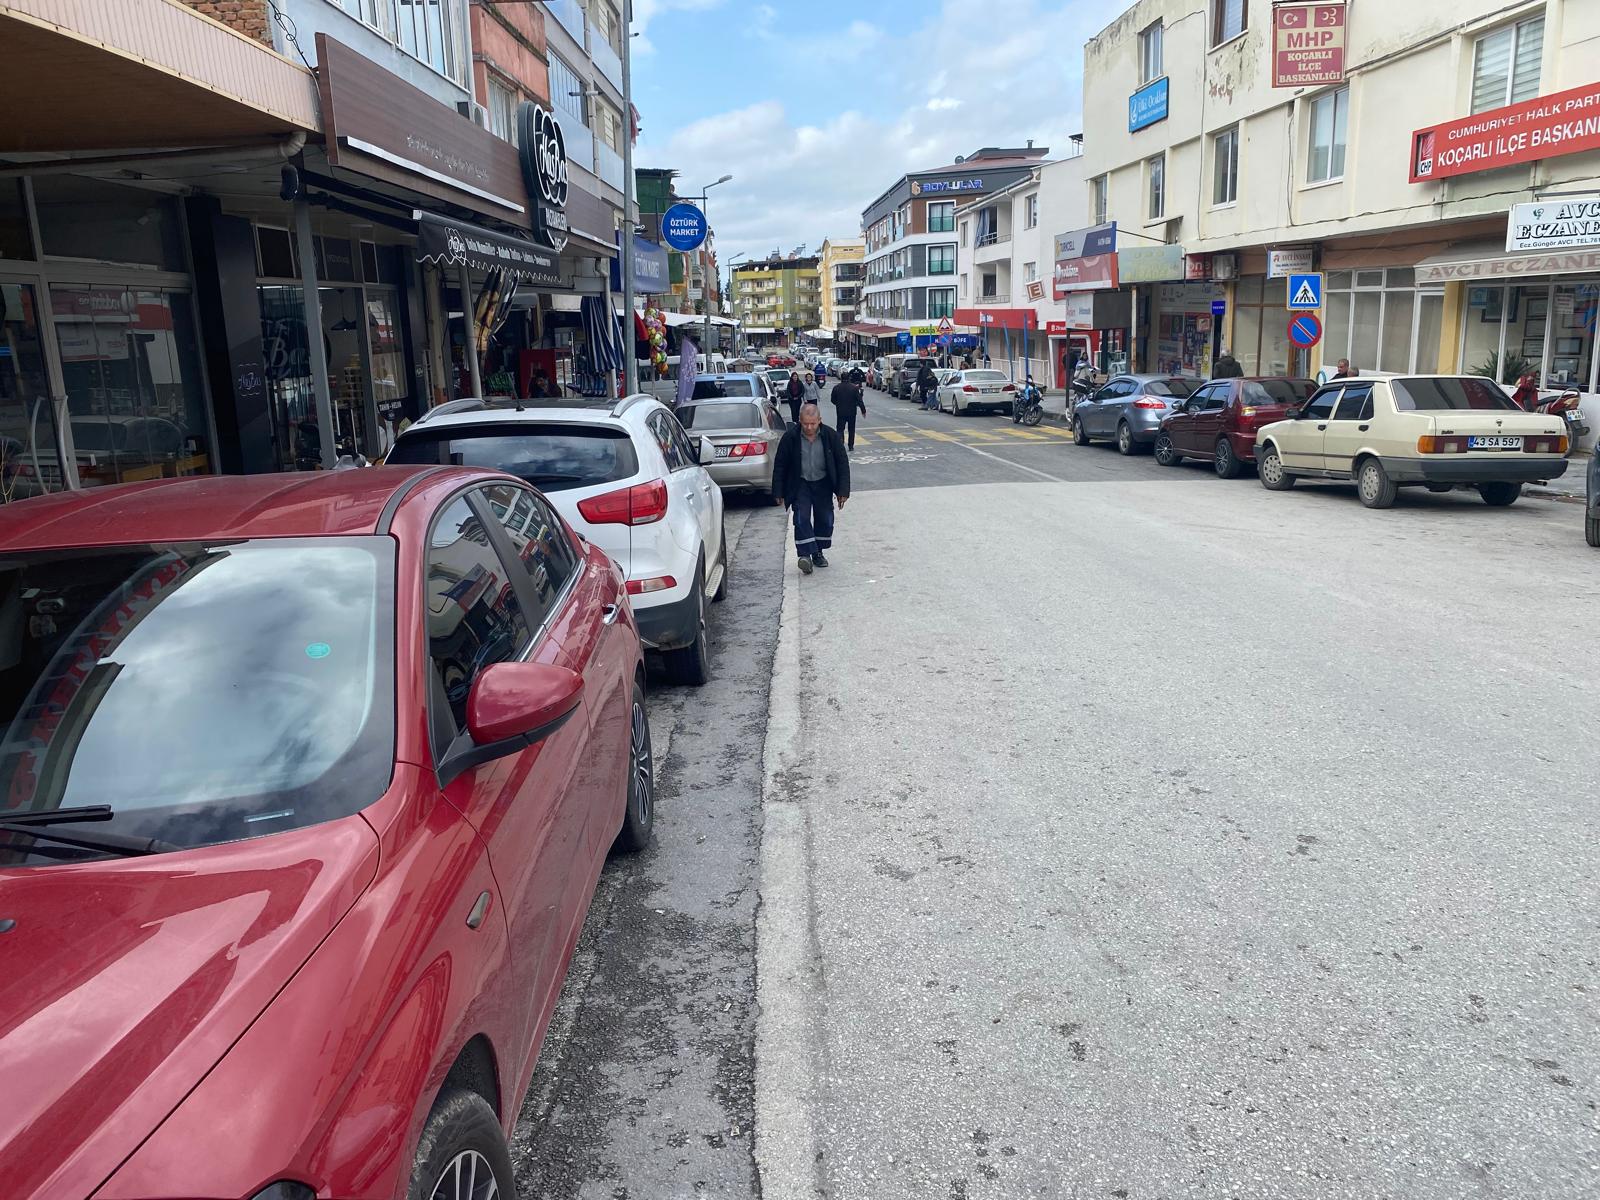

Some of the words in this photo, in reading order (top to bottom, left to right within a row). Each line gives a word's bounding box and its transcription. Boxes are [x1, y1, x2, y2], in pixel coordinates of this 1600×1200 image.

[1287, 31, 1333, 48] MHP
[1287, 50, 1333, 62] KOÇARLI
[1297, 62, 1322, 72] İLÇE
[1279, 71, 1340, 84] BAŞKANLIĞI
[1526, 103, 1561, 121] HALK
[1565, 93, 1600, 111] PART
[1438, 140, 1492, 167] KOÇARLI
[1495, 133, 1528, 156] İLÇE
[1420, 161, 1432, 173] CHP
[922, 180, 983, 192] BOYLULAR
[670, 218, 698, 227] ÖZTÜRK
[670, 228, 699, 236] MARKET
[1516, 221, 1600, 239] ECZANE
[1428, 263, 1482, 279] AVCI
[1490, 253, 1600, 274] ECZANE
[1474, 437, 1485, 446] 43
[1488, 437, 1499, 446] SA
[1502, 437, 1520, 446] 597
